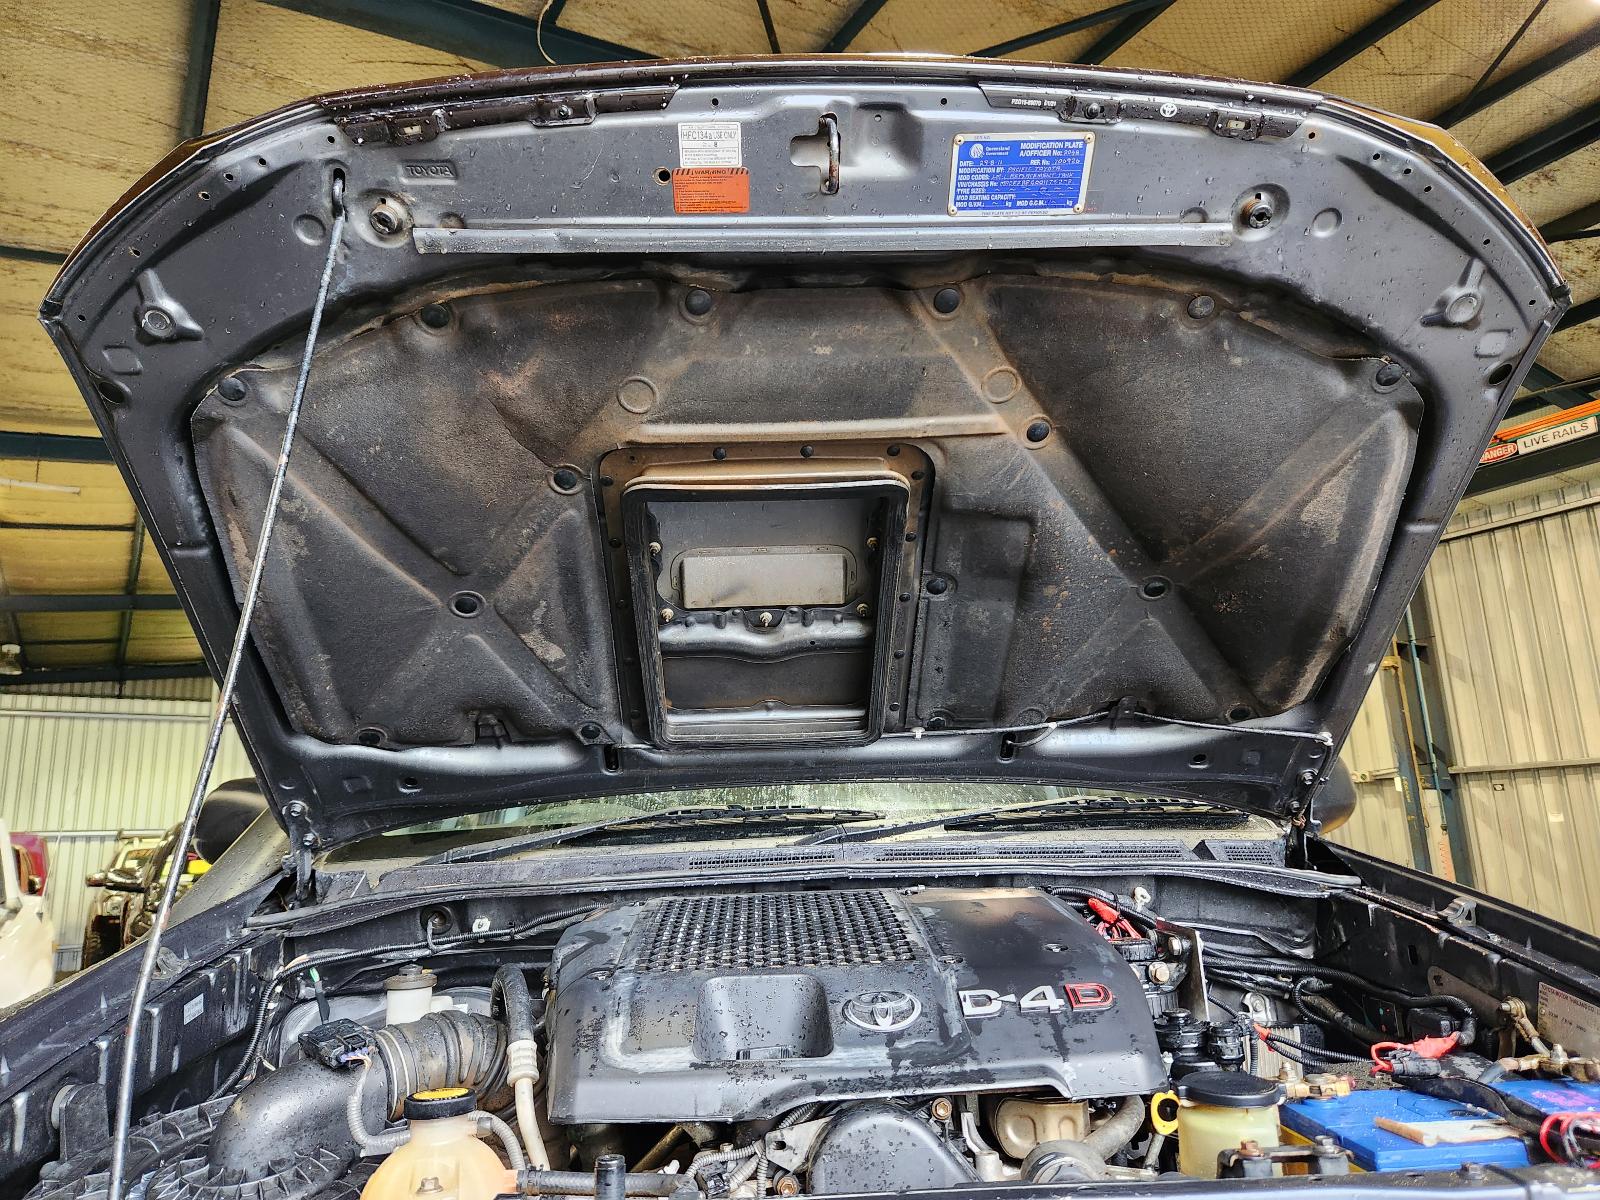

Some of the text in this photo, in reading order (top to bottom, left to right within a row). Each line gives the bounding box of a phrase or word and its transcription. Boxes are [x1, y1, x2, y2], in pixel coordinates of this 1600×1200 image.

[1020, 141, 1084, 150] MODIFICATION PLATE
[405, 164, 455, 178] TOYOTA
[1523, 434, 1551, 449] LIVE
[1552, 422, 1589, 440] RAILS
[957, 982, 1115, 1020] D-4D
